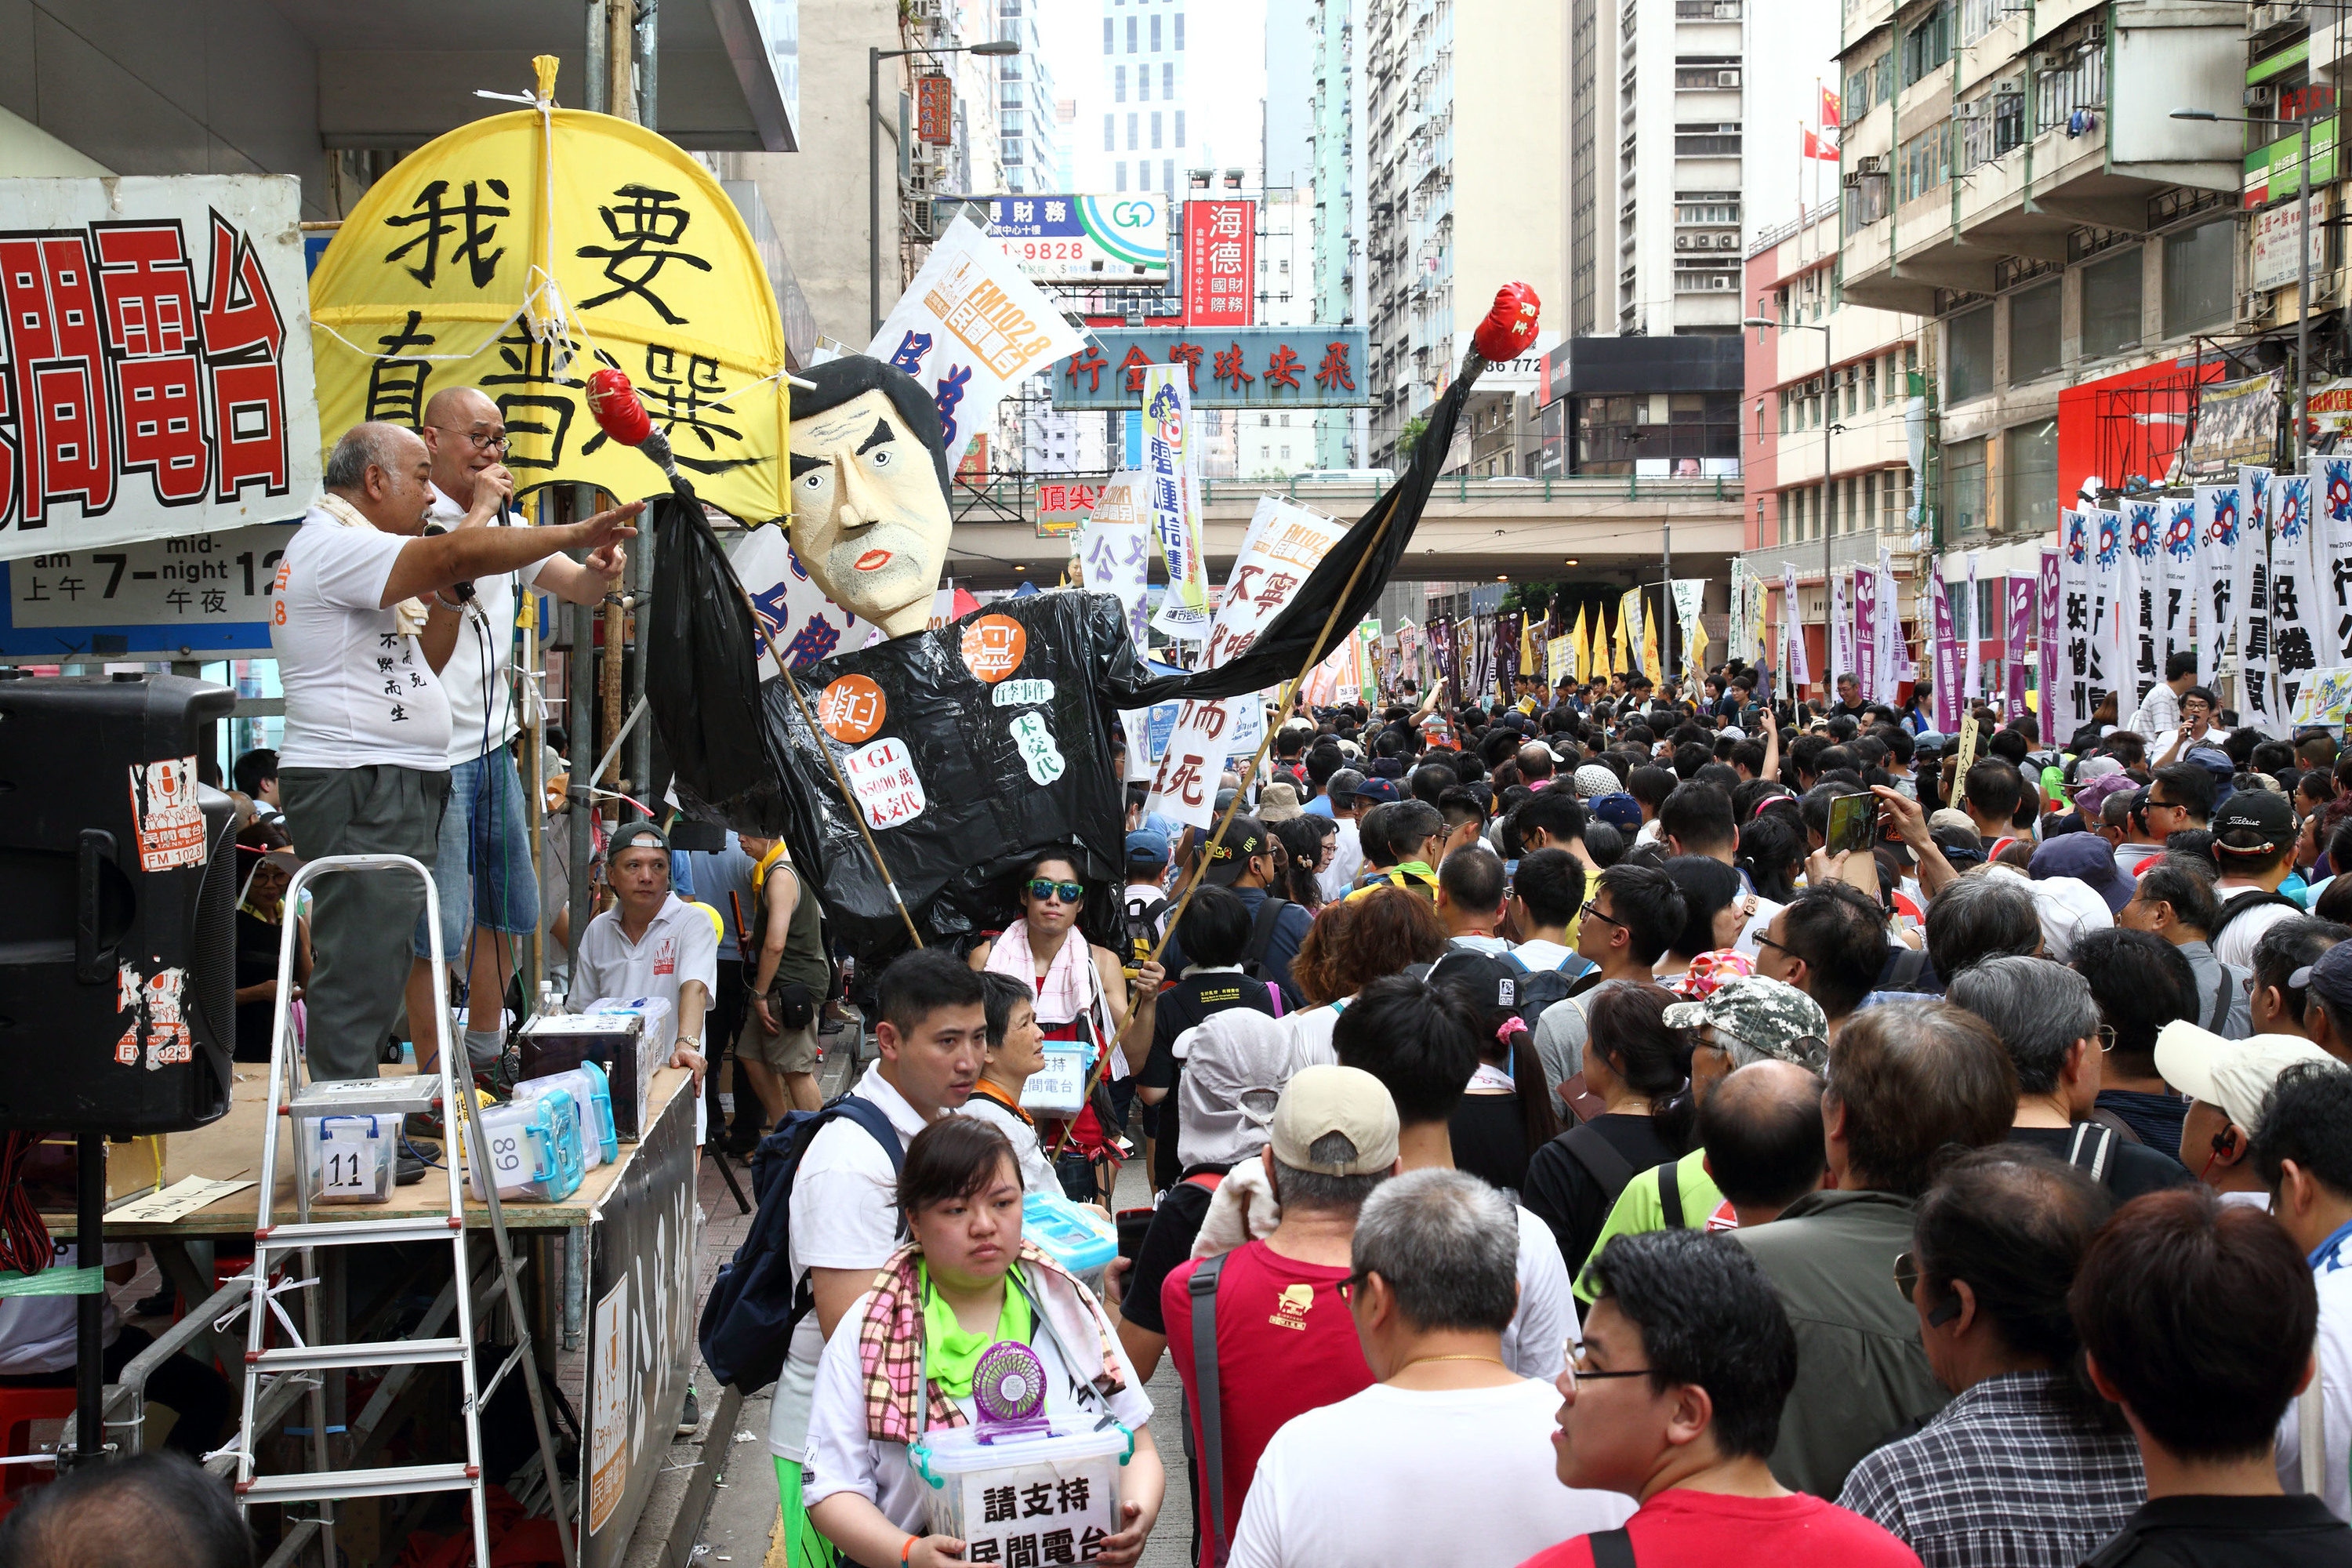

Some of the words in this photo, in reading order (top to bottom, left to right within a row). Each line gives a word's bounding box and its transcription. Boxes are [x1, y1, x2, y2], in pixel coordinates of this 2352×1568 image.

[383, 179, 713, 325] 我要
[0, 205, 290, 532] 間電台
[162, 560, 228, 584] night
[23, 576, 85, 601] 上午
[165, 588, 228, 614] 午夜
[995, 681, 1047, 703] 行李事件
[848, 743, 900, 775] UGL
[1018, 715, 1060, 780] 未交代
[898, 768, 915, 788] 萬
[868, 790, 920, 826] 未交代
[2227, 815, 2260, 826] Titleist
[147, 853, 169, 866] FM
[175, 845, 201, 862] 102.8
[328, 1152, 363, 1187] 11
[982, 1475, 1091, 1524] 請支持
